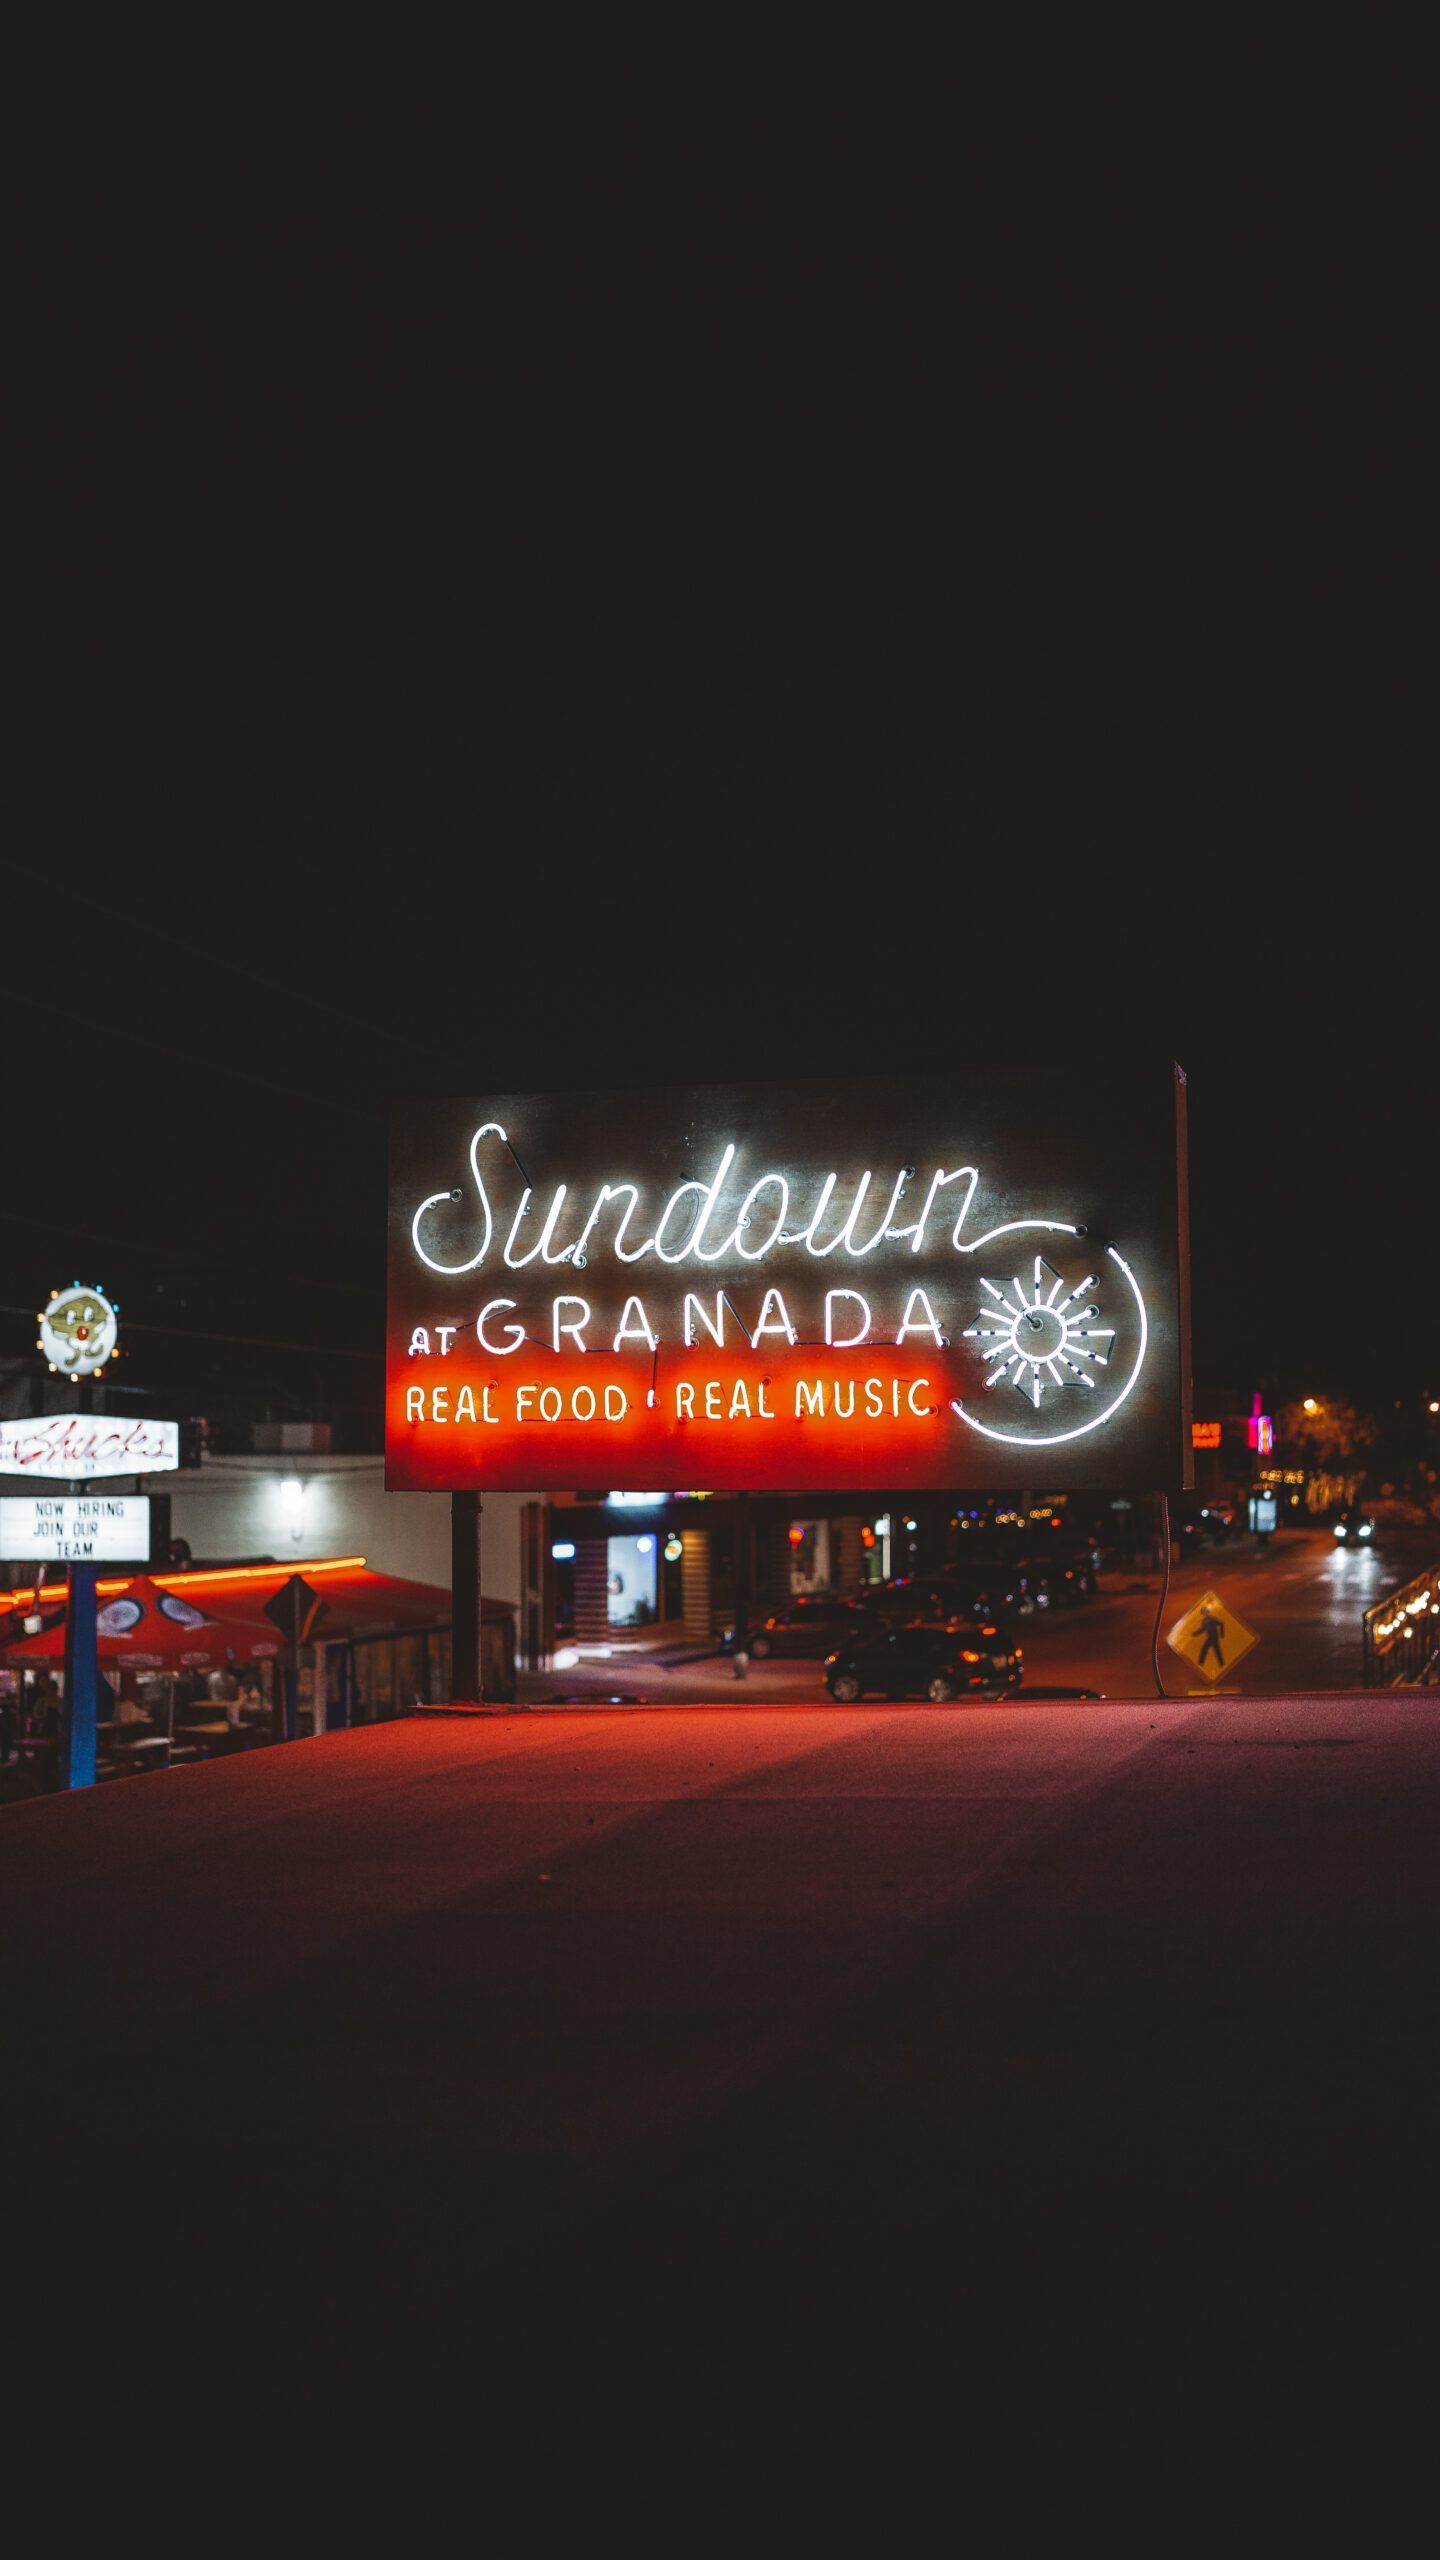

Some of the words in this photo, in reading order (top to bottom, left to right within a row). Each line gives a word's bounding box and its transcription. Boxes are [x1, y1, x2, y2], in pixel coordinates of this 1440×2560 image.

[411, 1122, 1080, 1274] Sundown
[408, 1327, 456, 1356] AT
[477, 1288, 943, 1355] GRANADA
[406, 1385, 499, 1423] REAL
[516, 1385, 627, 1423] FOOD
[676, 1379, 775, 1419] REAL
[795, 1378, 930, 1418] MUSIC
[20, 1420, 173, 1465] Shucks
[33, 1522, 63, 1536] JOIN
[73, 1521, 98, 1536] OUR
[35, 1502, 63, 1517] NOW
[78, 1502, 124, 1517] HIRING
[57, 1542, 93, 1557] TEAM
